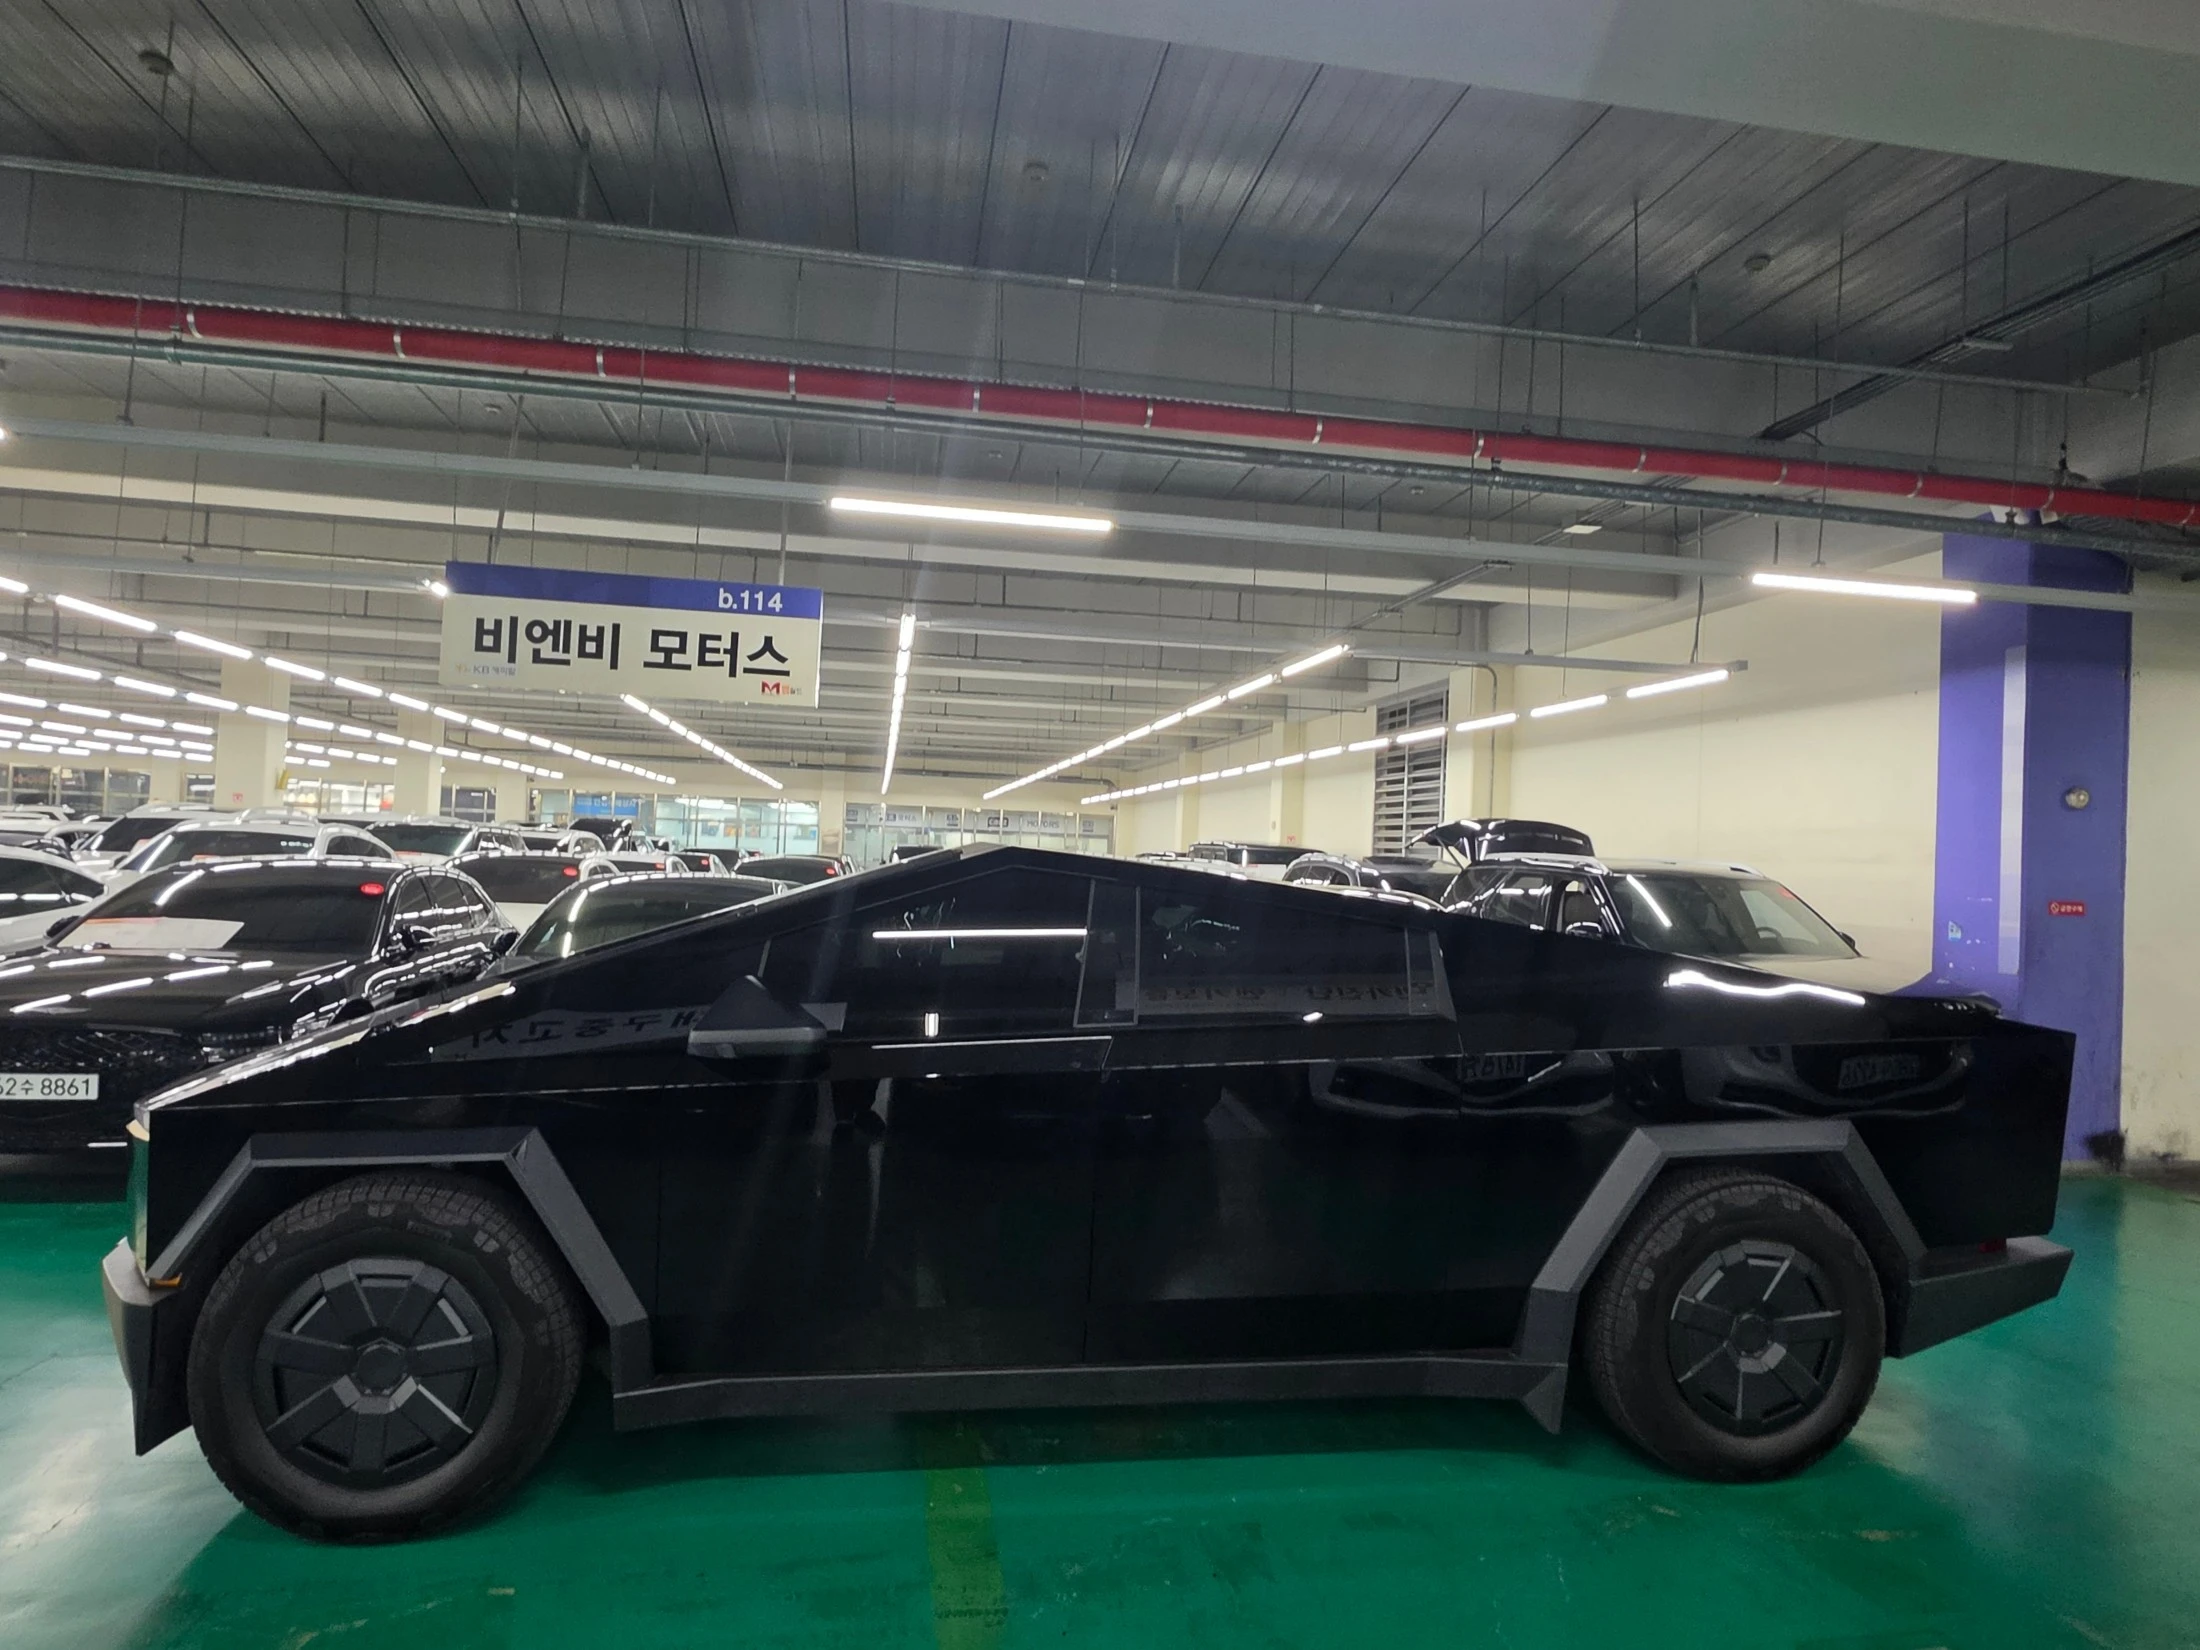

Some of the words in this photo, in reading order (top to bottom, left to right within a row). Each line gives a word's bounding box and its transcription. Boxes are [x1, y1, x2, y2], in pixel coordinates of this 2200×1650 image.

[718, 588, 783, 613] b.114
[474, 615, 621, 671] 비엔비
[643, 628, 791, 678] 모터스
[473, 664, 490, 675] KB
[40, 1077, 90, 1097] 8861
